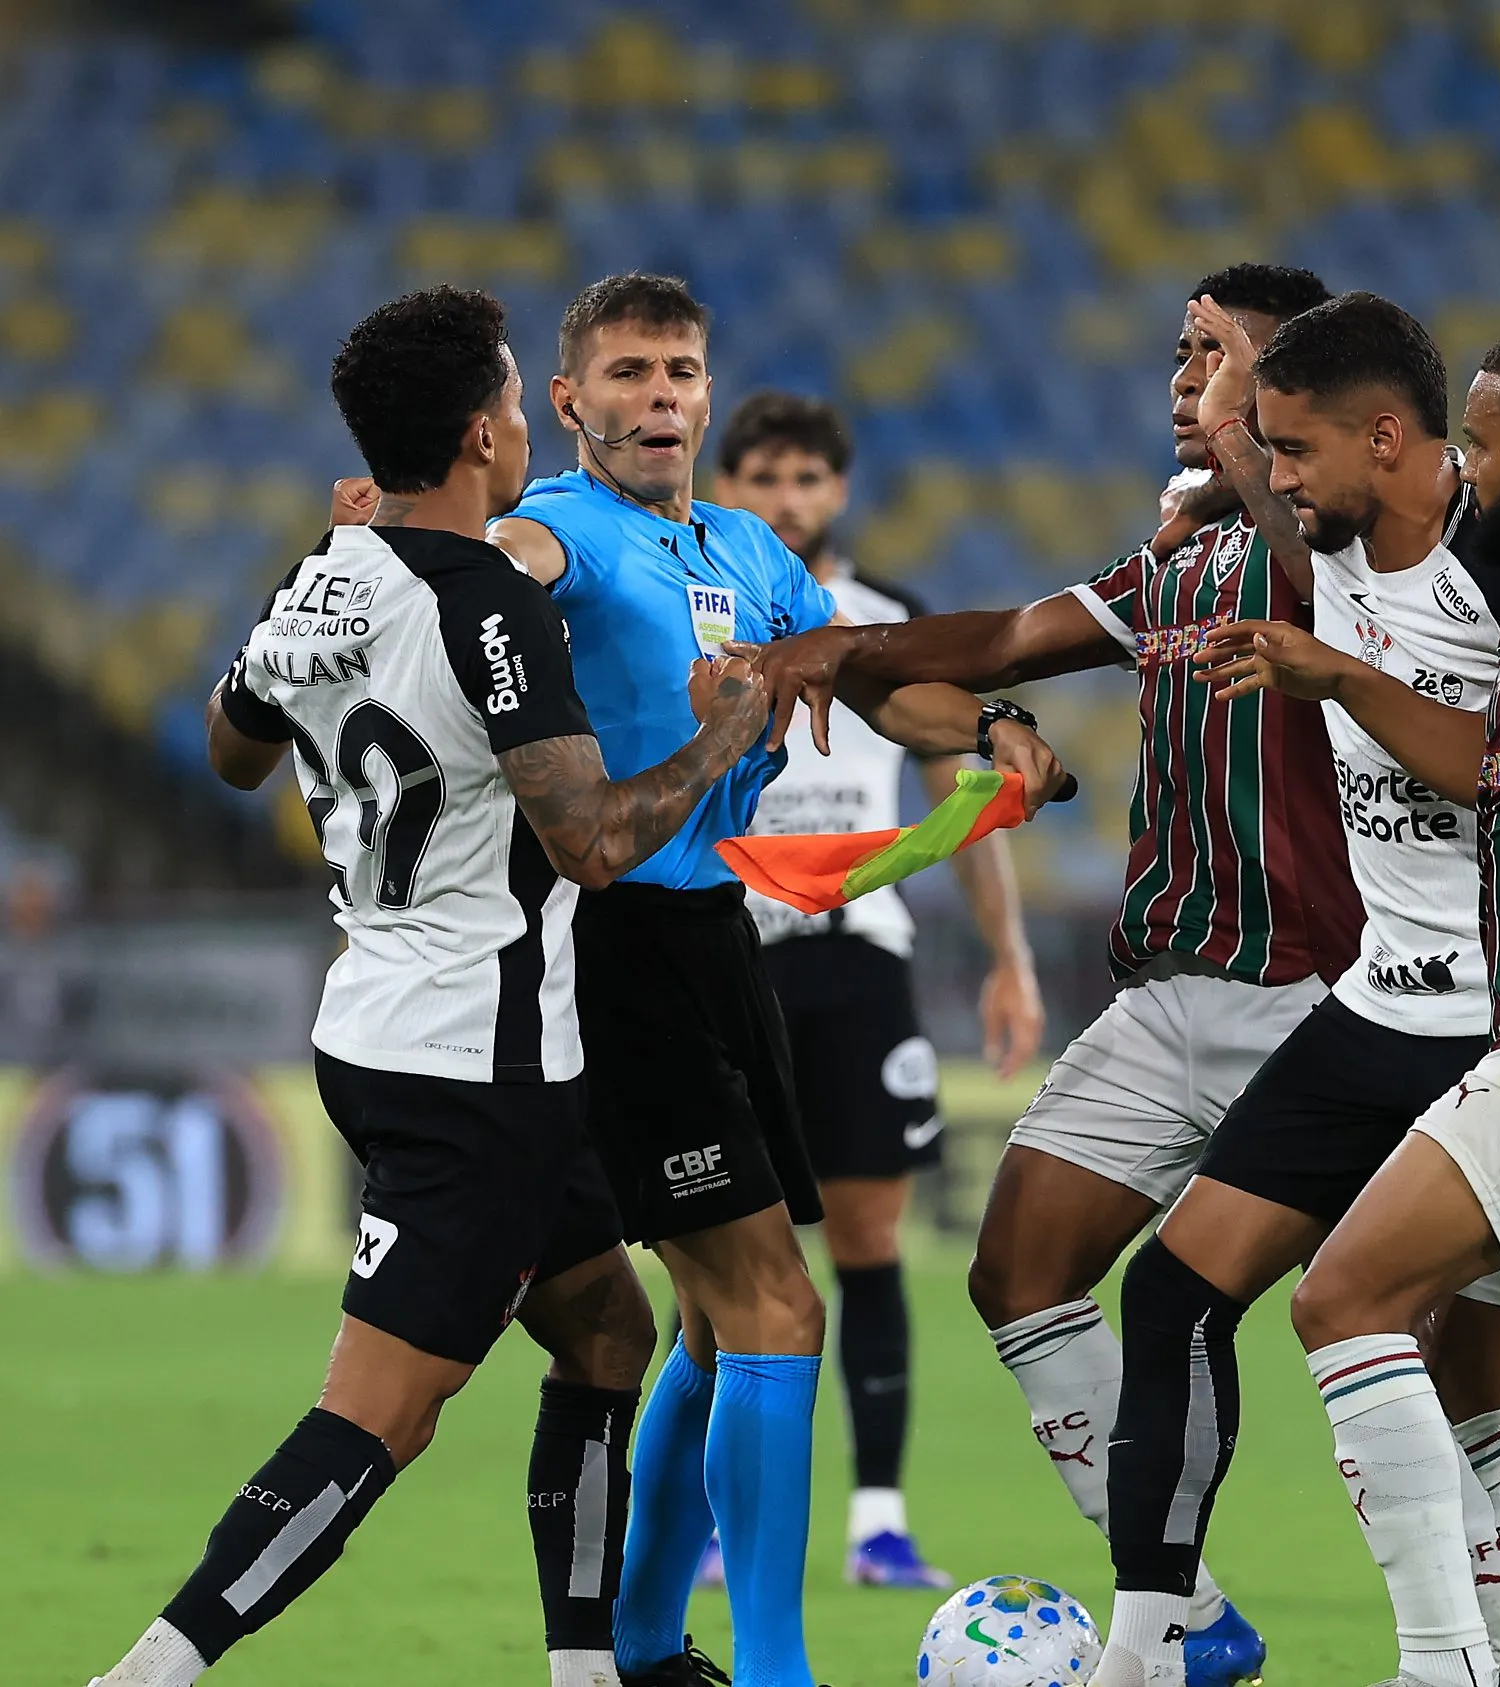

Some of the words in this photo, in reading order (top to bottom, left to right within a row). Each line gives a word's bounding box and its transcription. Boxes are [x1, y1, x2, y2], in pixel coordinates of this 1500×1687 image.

[693, 590, 731, 616] FIFA
[313, 617, 370, 636] AUTO
[484, 633, 521, 715] bmg
[512, 654, 529, 693] banco
[1411, 668, 1440, 696] Zé
[663, 1143, 722, 1181] CBF
[65, 1092, 224, 1271] 51
[672, 1188, 689, 1200] TIME
[1032, 1410, 1090, 1444] FFC
[235, 1483, 292, 1512] SCCP
